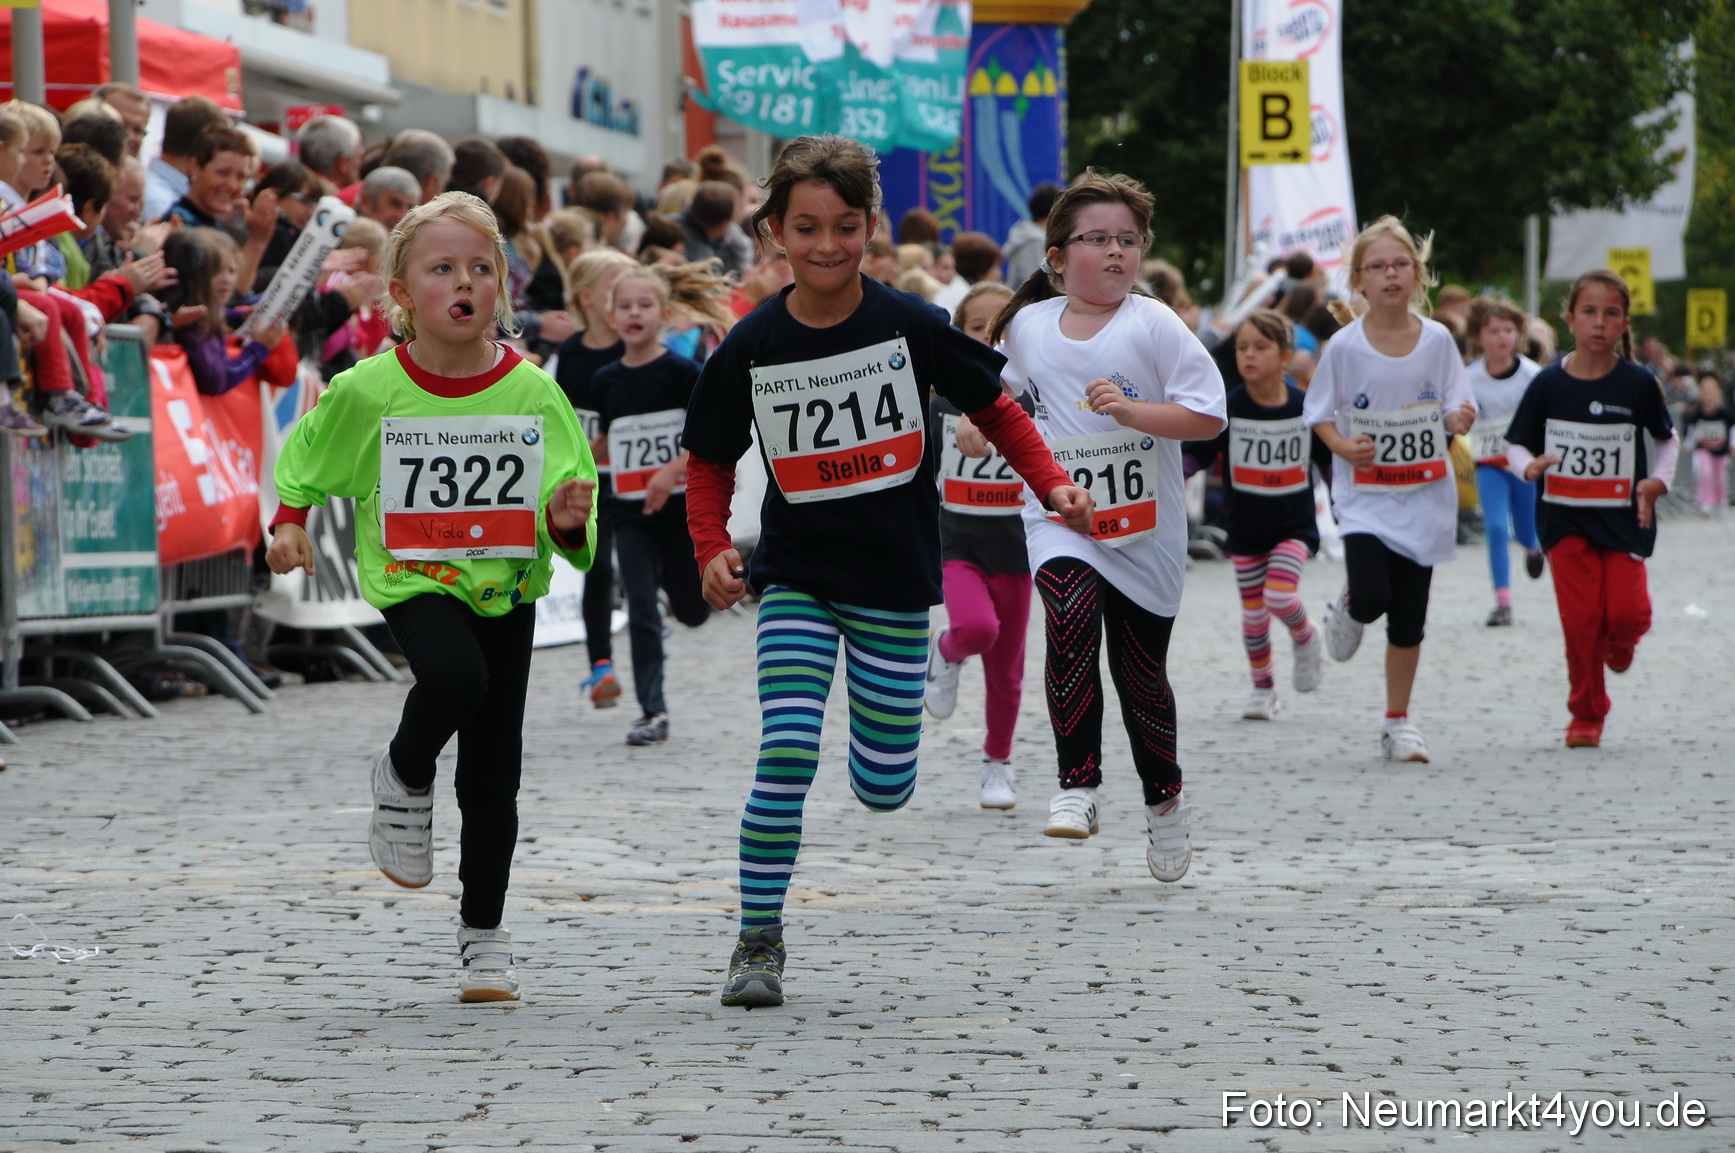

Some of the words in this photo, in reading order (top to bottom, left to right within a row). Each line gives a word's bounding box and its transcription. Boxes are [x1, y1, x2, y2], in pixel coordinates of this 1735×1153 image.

[1248, 64, 1303, 83] Block
[1261, 94, 1293, 140] B
[754, 378, 805, 397] PARTL
[808, 361, 884, 389] Neumarkt
[773, 382, 904, 453] 7214
[909, 419, 919, 429] W
[1353, 417, 1381, 427] PARTL
[1384, 416, 1428, 428] Neumarkt
[386, 432, 434, 446] PARTL
[438, 431, 515, 446] Neumarkt
[1239, 435, 1300, 465] 7040
[1054, 450, 1074, 463] RTL
[1076, 441, 1136, 458] Neumarkt
[1555, 443, 1620, 476] 7331
[817, 452, 882, 483] Stella
[1263, 473, 1281, 485] Ida
[1376, 469, 1424, 482] Aurelia
[399, 454, 524, 508] 7322
[1066, 459, 1144, 507] 216
[967, 488, 1017, 503] Leonie
[420, 519, 464, 540] Viola
[384, 560, 462, 586] MERZ
